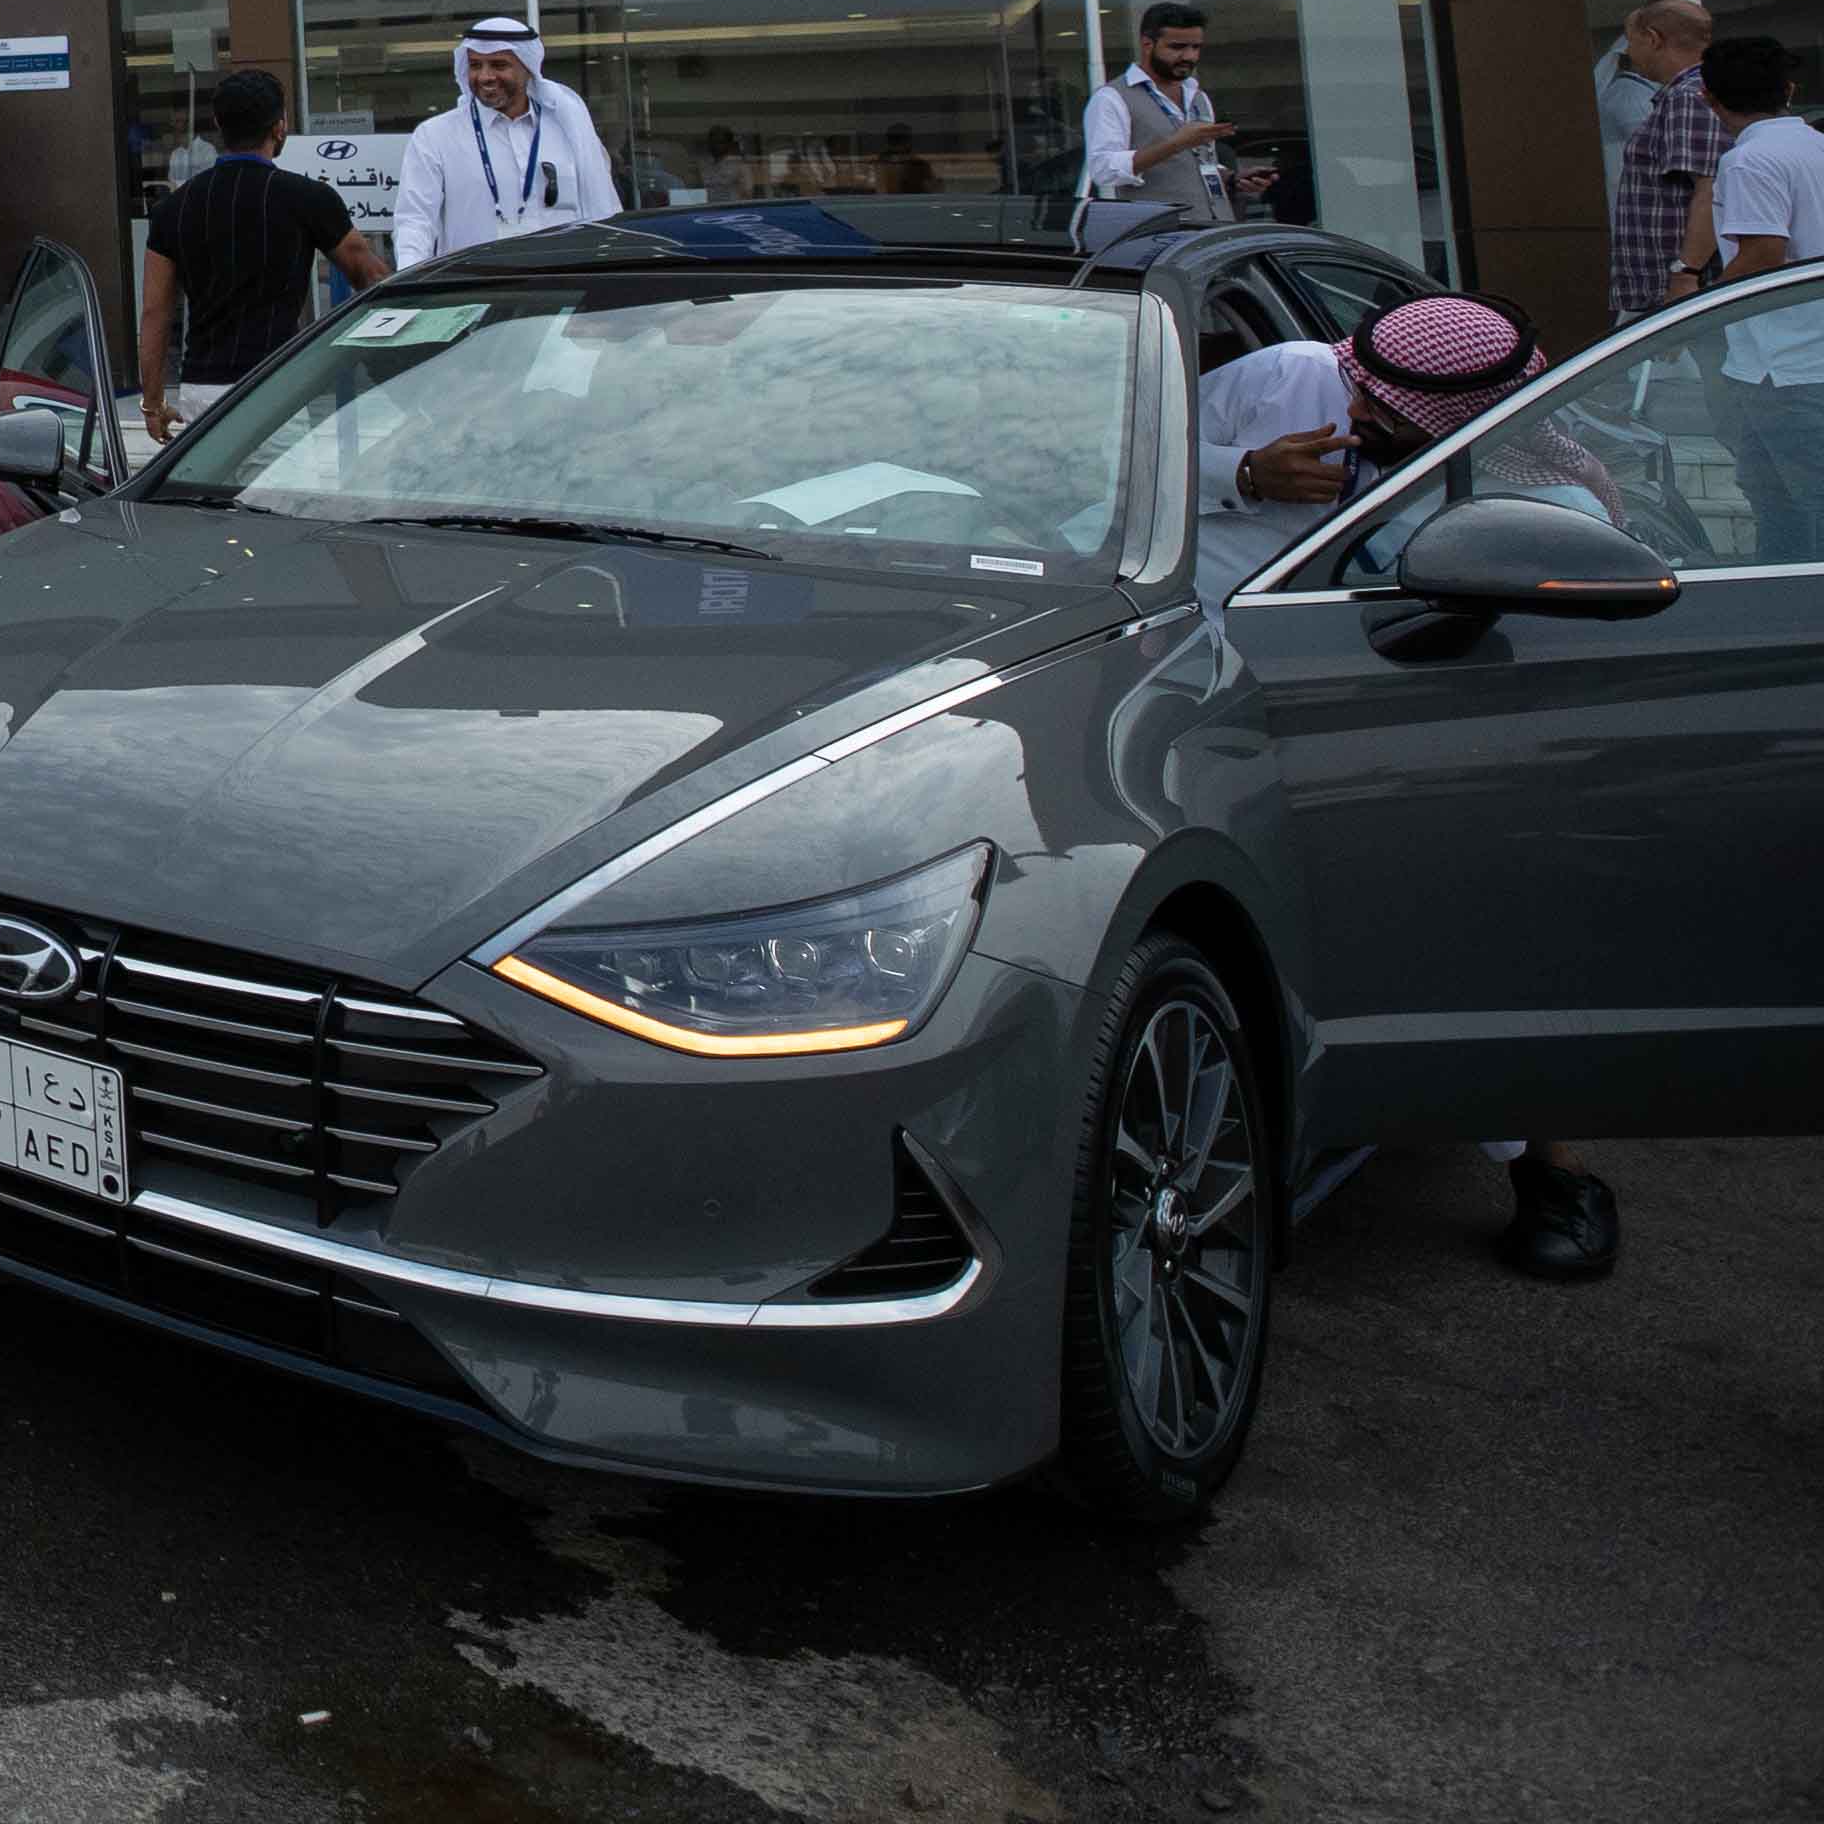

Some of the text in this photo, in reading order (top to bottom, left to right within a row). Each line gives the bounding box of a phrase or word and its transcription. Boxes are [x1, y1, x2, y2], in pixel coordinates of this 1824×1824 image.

[336, 169, 400, 191] واقف
[24, 1127, 90, 1176] AED
[103, 1113, 115, 1161] KSA
